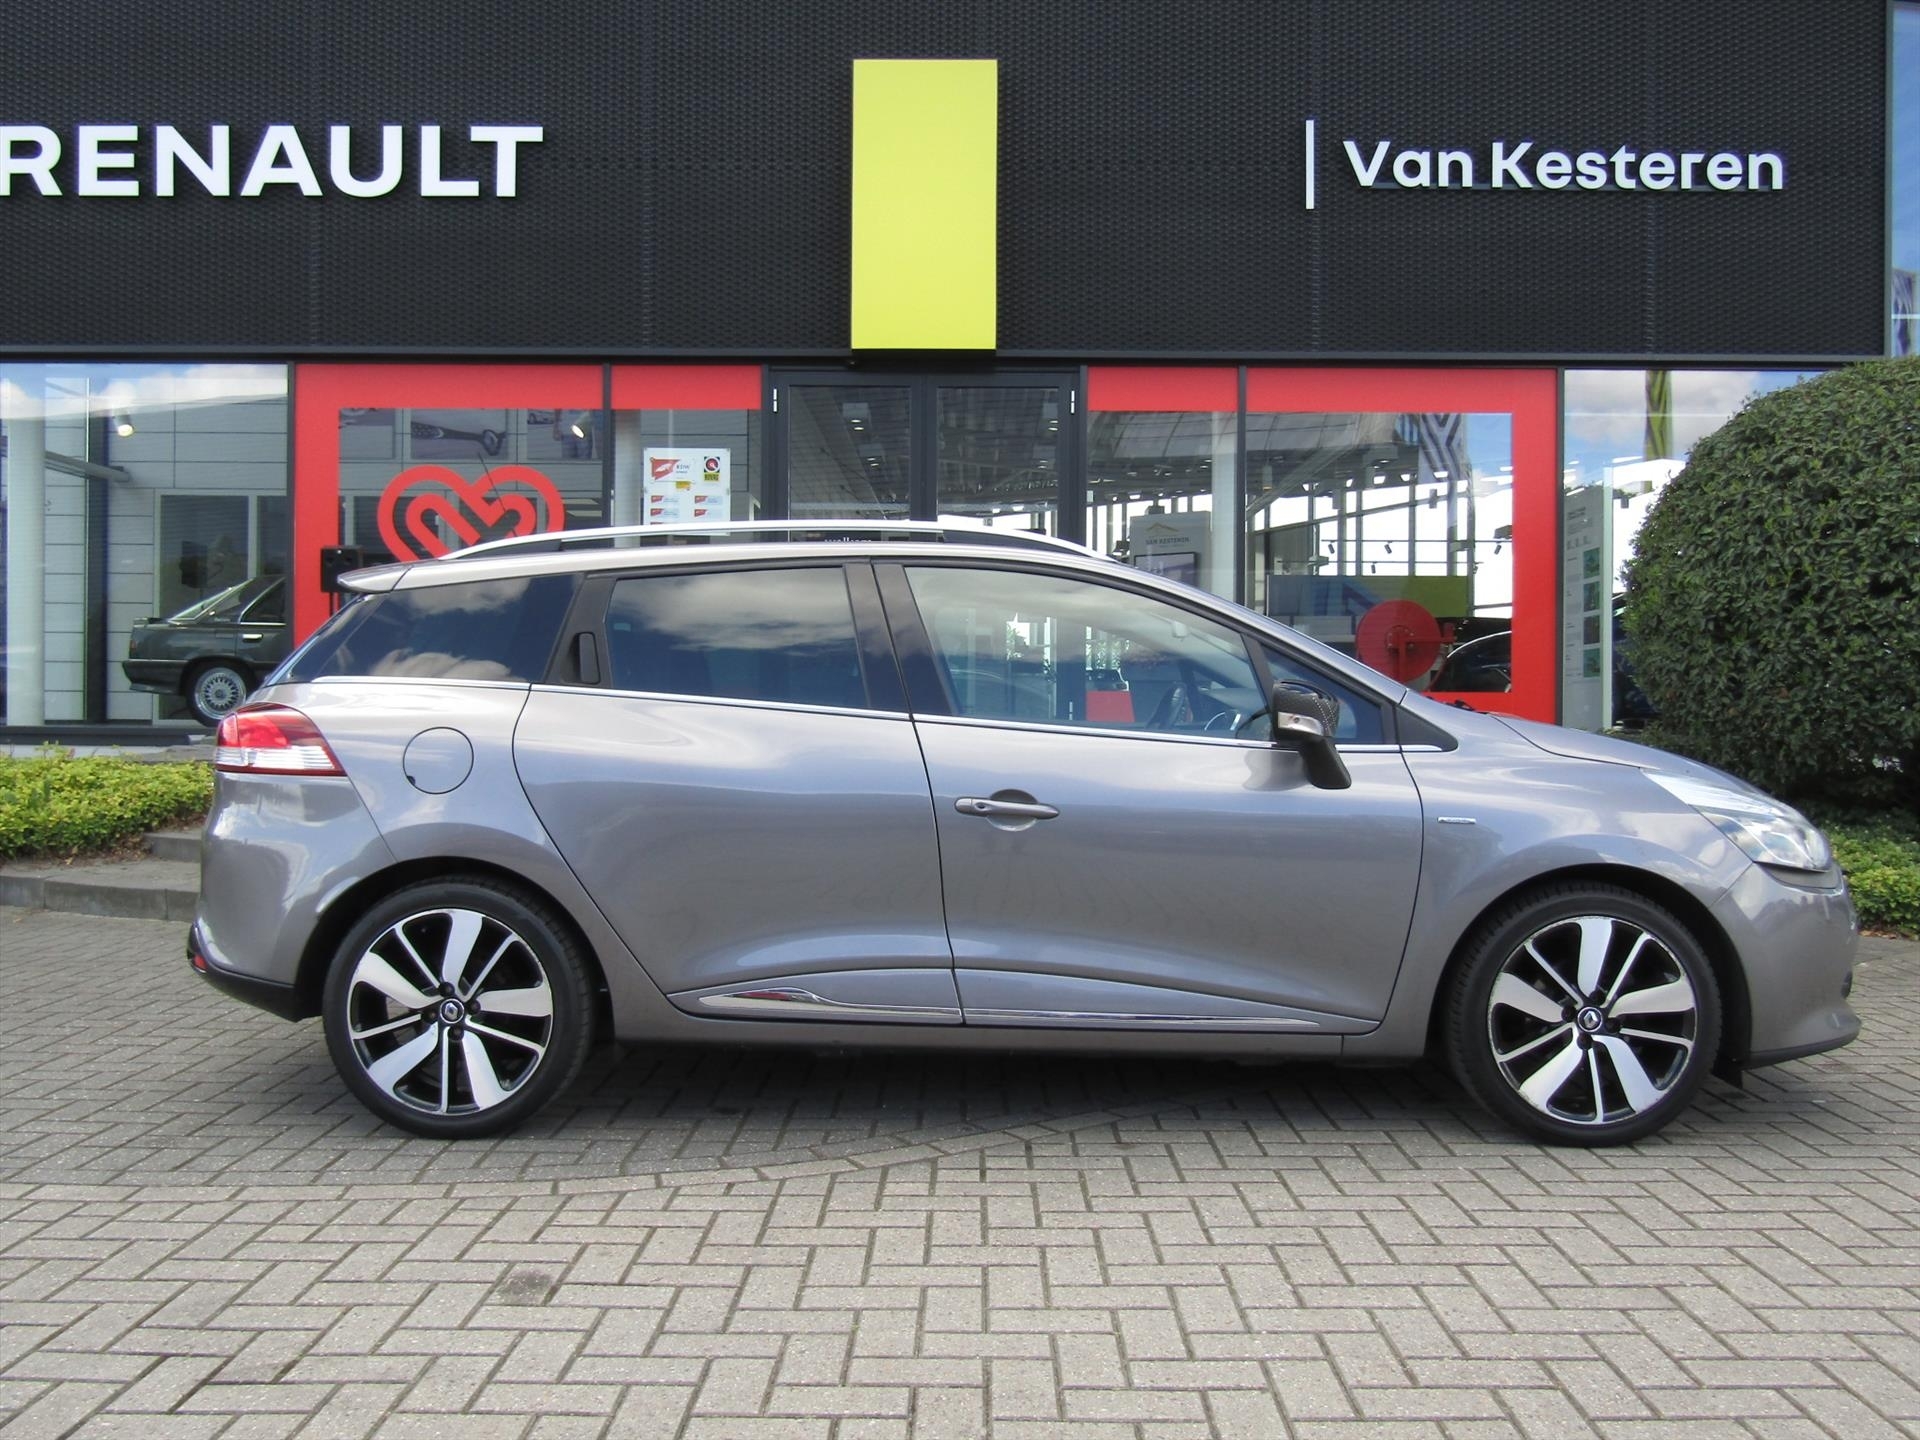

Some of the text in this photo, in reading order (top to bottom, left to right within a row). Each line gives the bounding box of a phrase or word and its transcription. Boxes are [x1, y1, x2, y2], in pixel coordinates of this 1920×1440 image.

[0, 125, 544, 198] RENAULT
[1343, 140, 1784, 191] Van Kesteren
